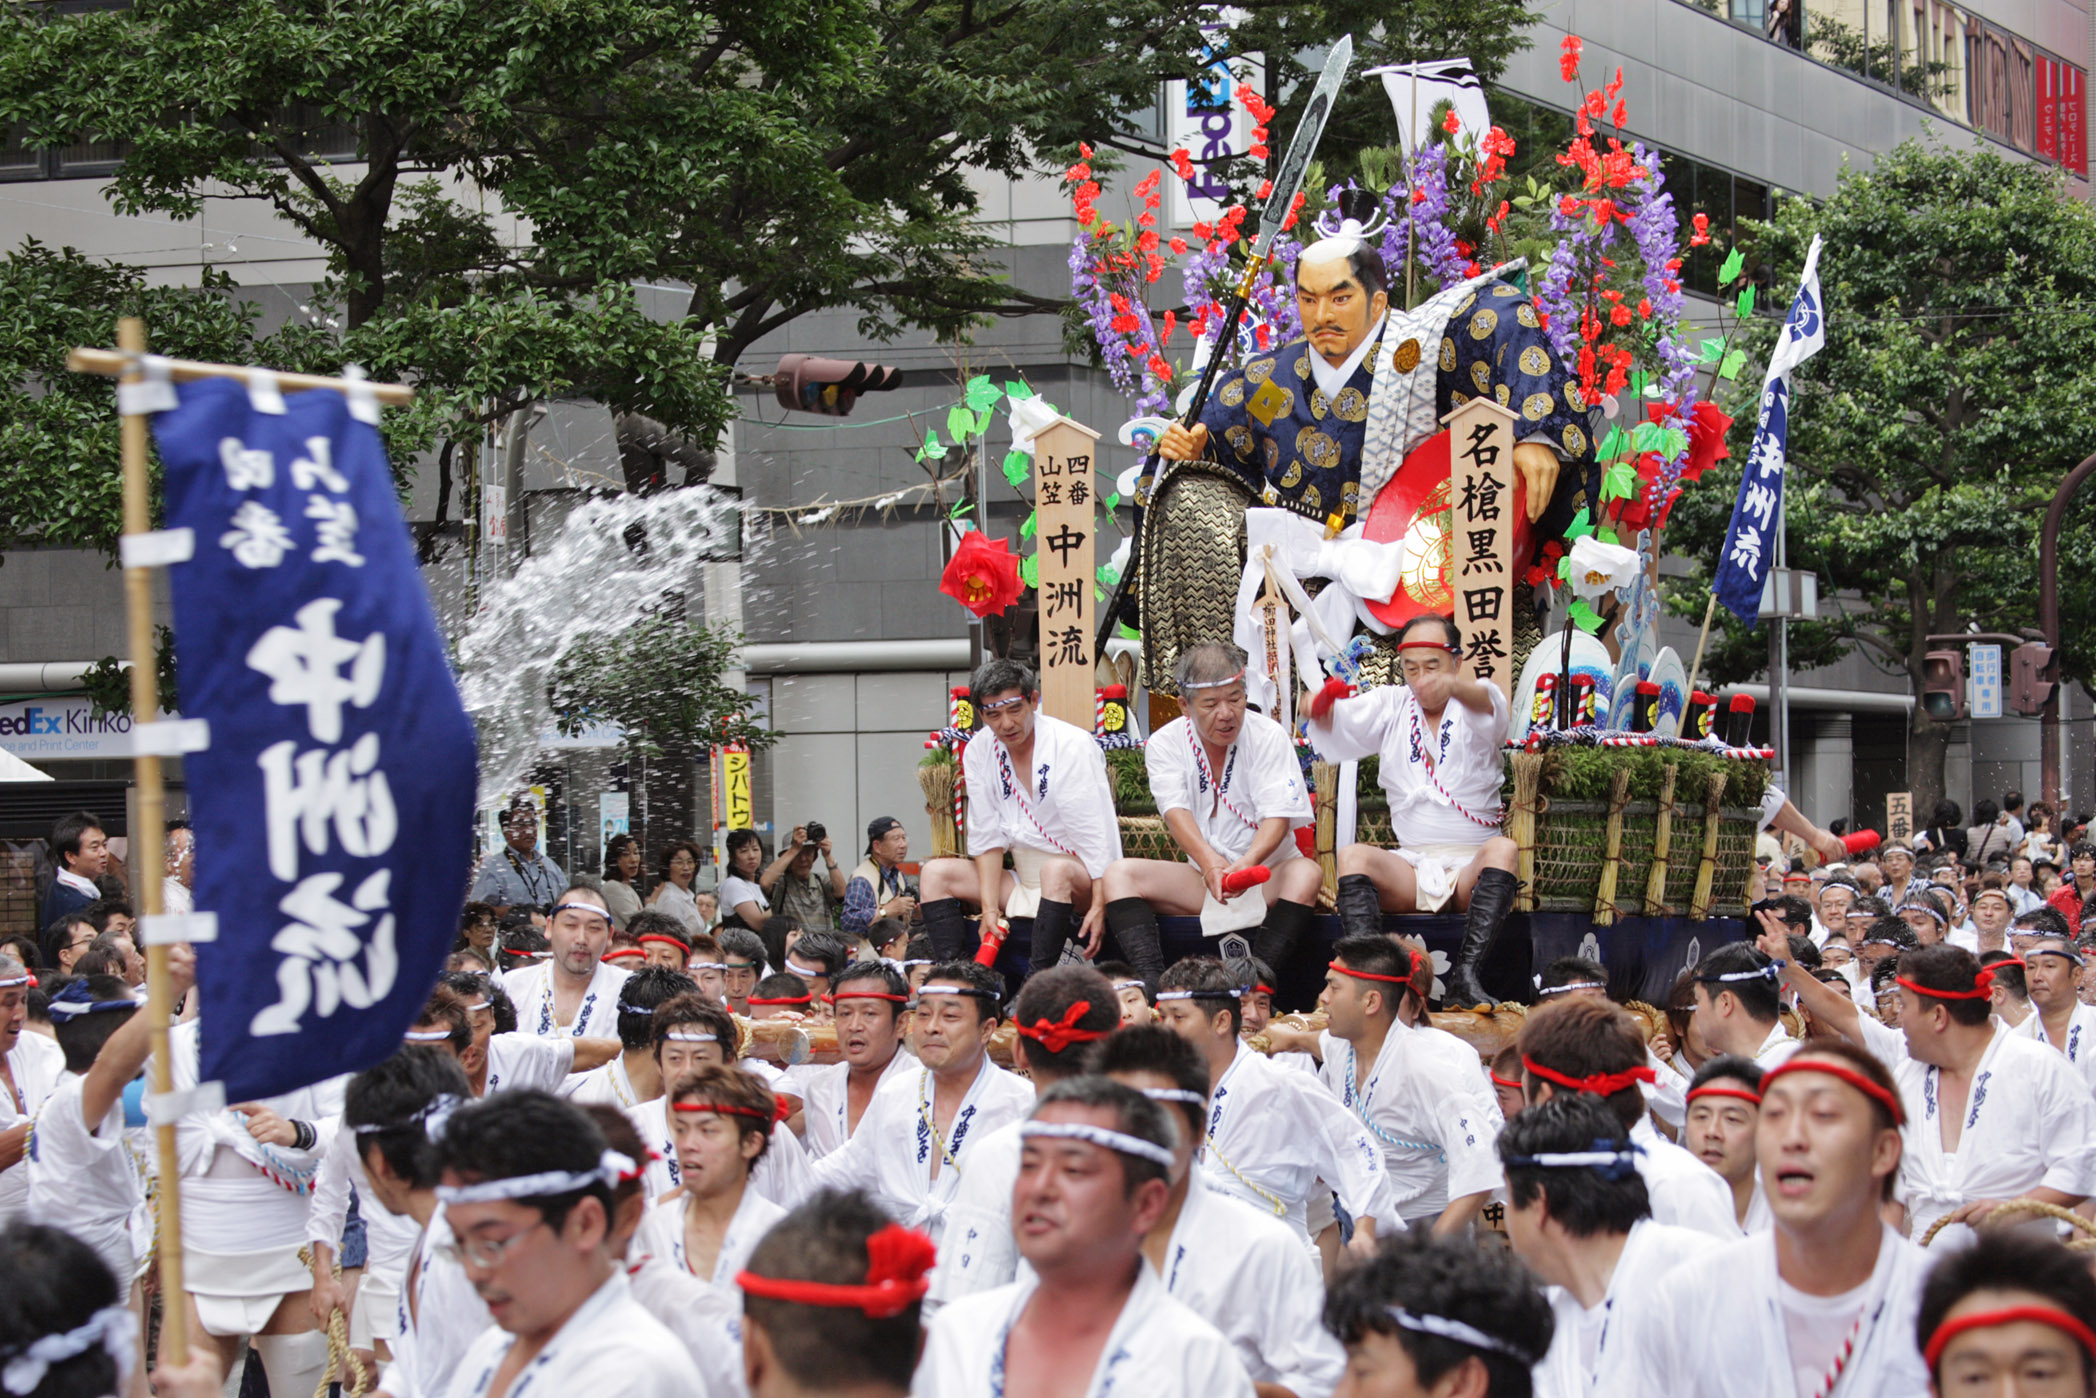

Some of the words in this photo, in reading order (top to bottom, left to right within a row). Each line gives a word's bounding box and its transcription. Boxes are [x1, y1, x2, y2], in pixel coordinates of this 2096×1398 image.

[1039, 455, 1062, 506] 山笠
[1066, 455, 1091, 506] 四番
[1457, 423, 1507, 680] 名槍黒田誉
[1046, 523, 1089, 668] 中洲流
[0, 707, 62, 735] edEx
[18, 739, 36, 752] and
[40, 739, 62, 751] Print
[65, 738, 99, 751] Center
[1890, 796, 1910, 838] 五番
